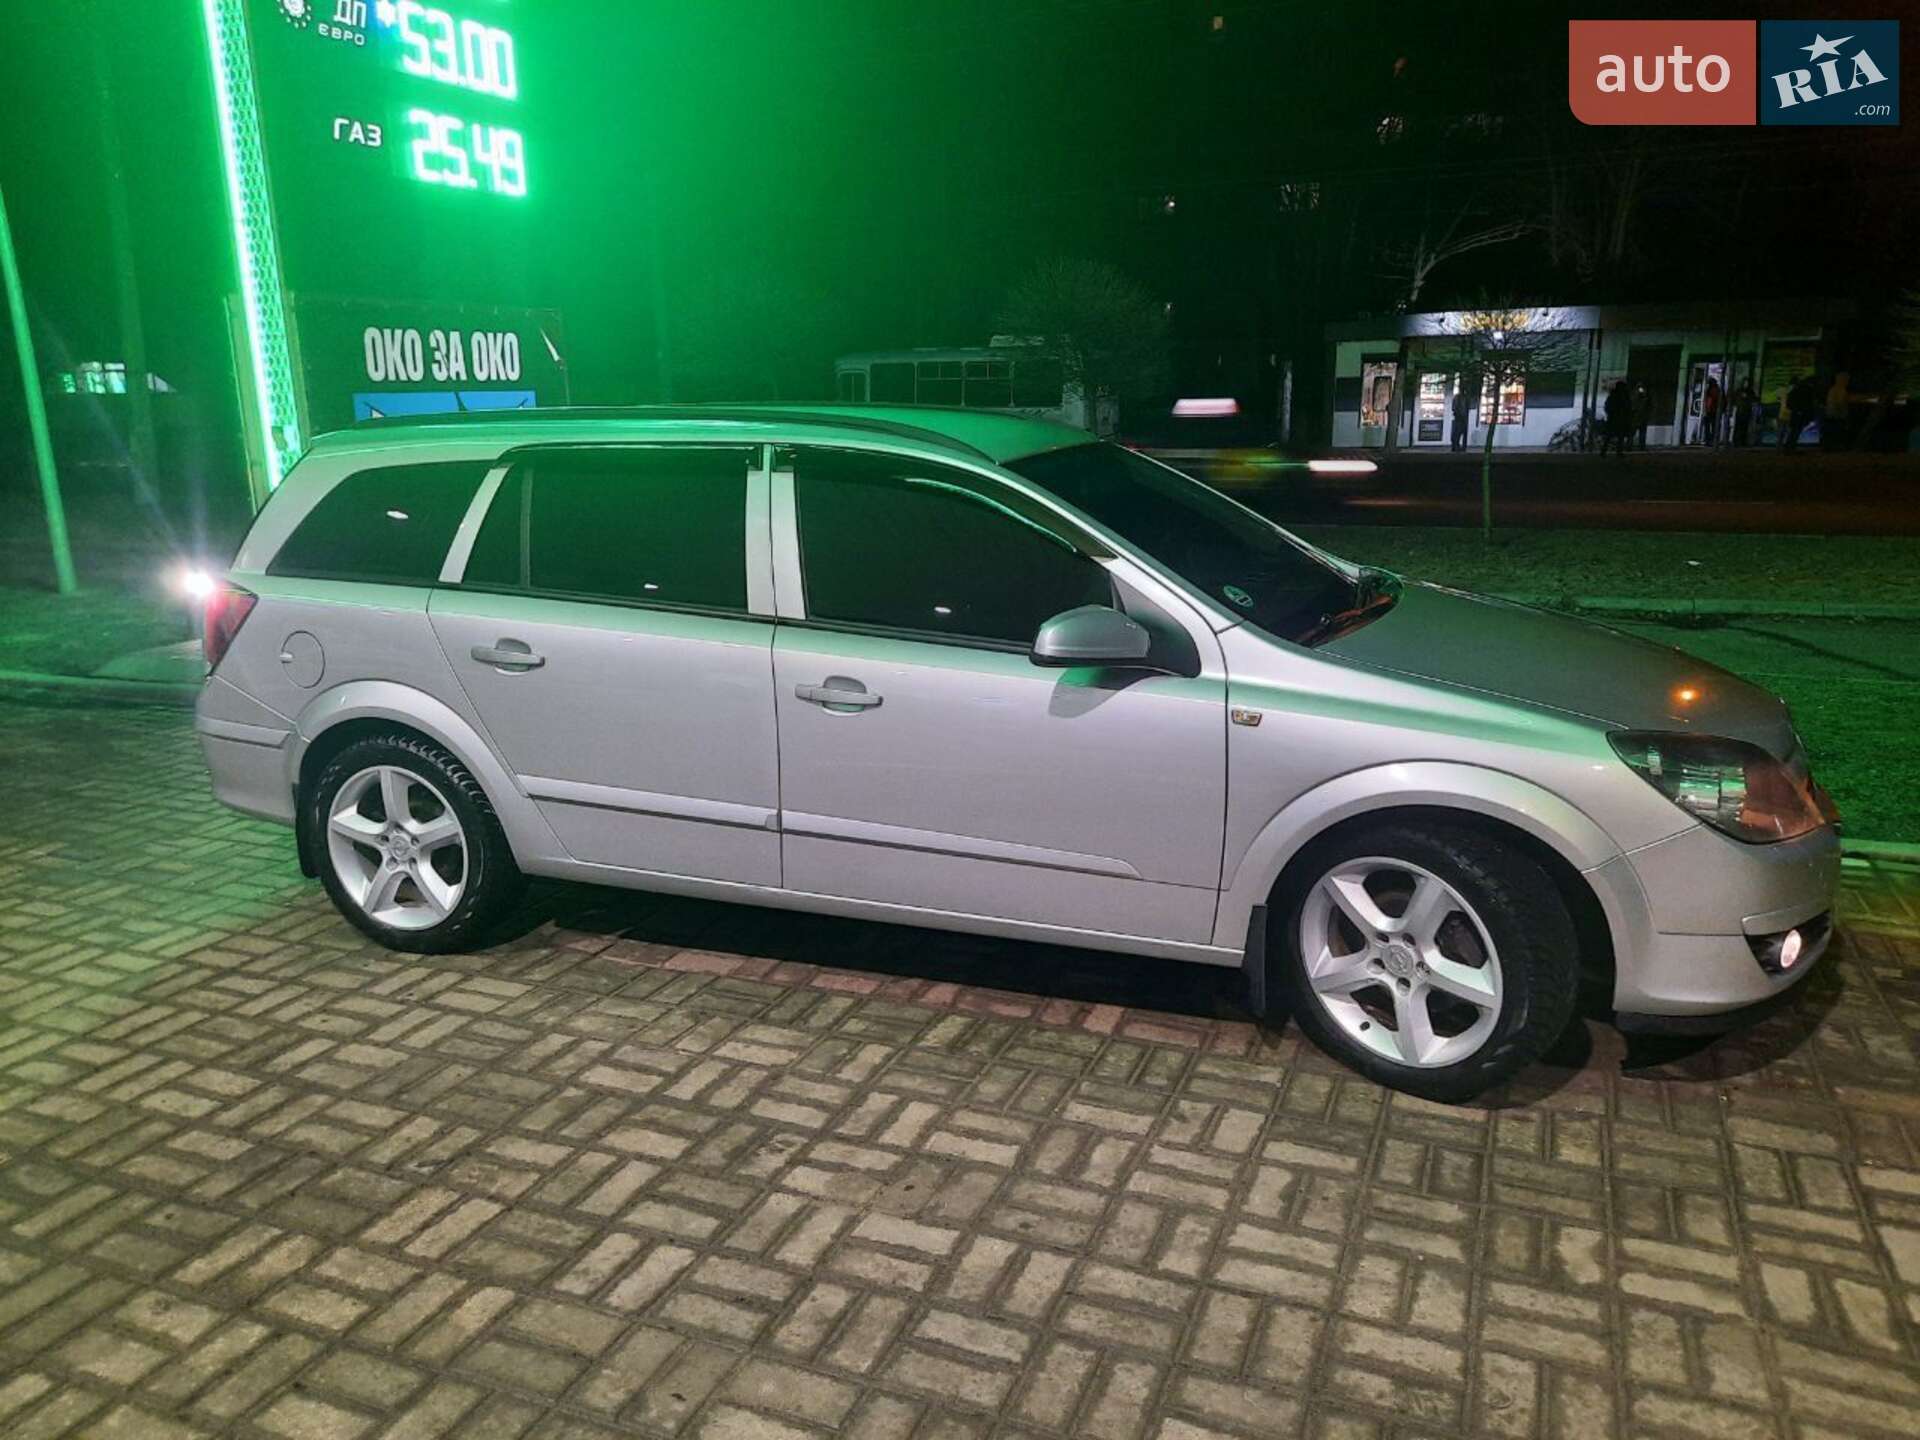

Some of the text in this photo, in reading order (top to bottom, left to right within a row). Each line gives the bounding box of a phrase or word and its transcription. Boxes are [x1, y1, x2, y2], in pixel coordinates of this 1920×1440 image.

[317, 22, 366, 46] ЄВРО
[399, 1, 518, 100] 53.00
[333, 117, 383, 148] ГАЗ
[408, 106, 527, 197] 25.49
[363, 326, 521, 382] ОКО ЗА ОКО
